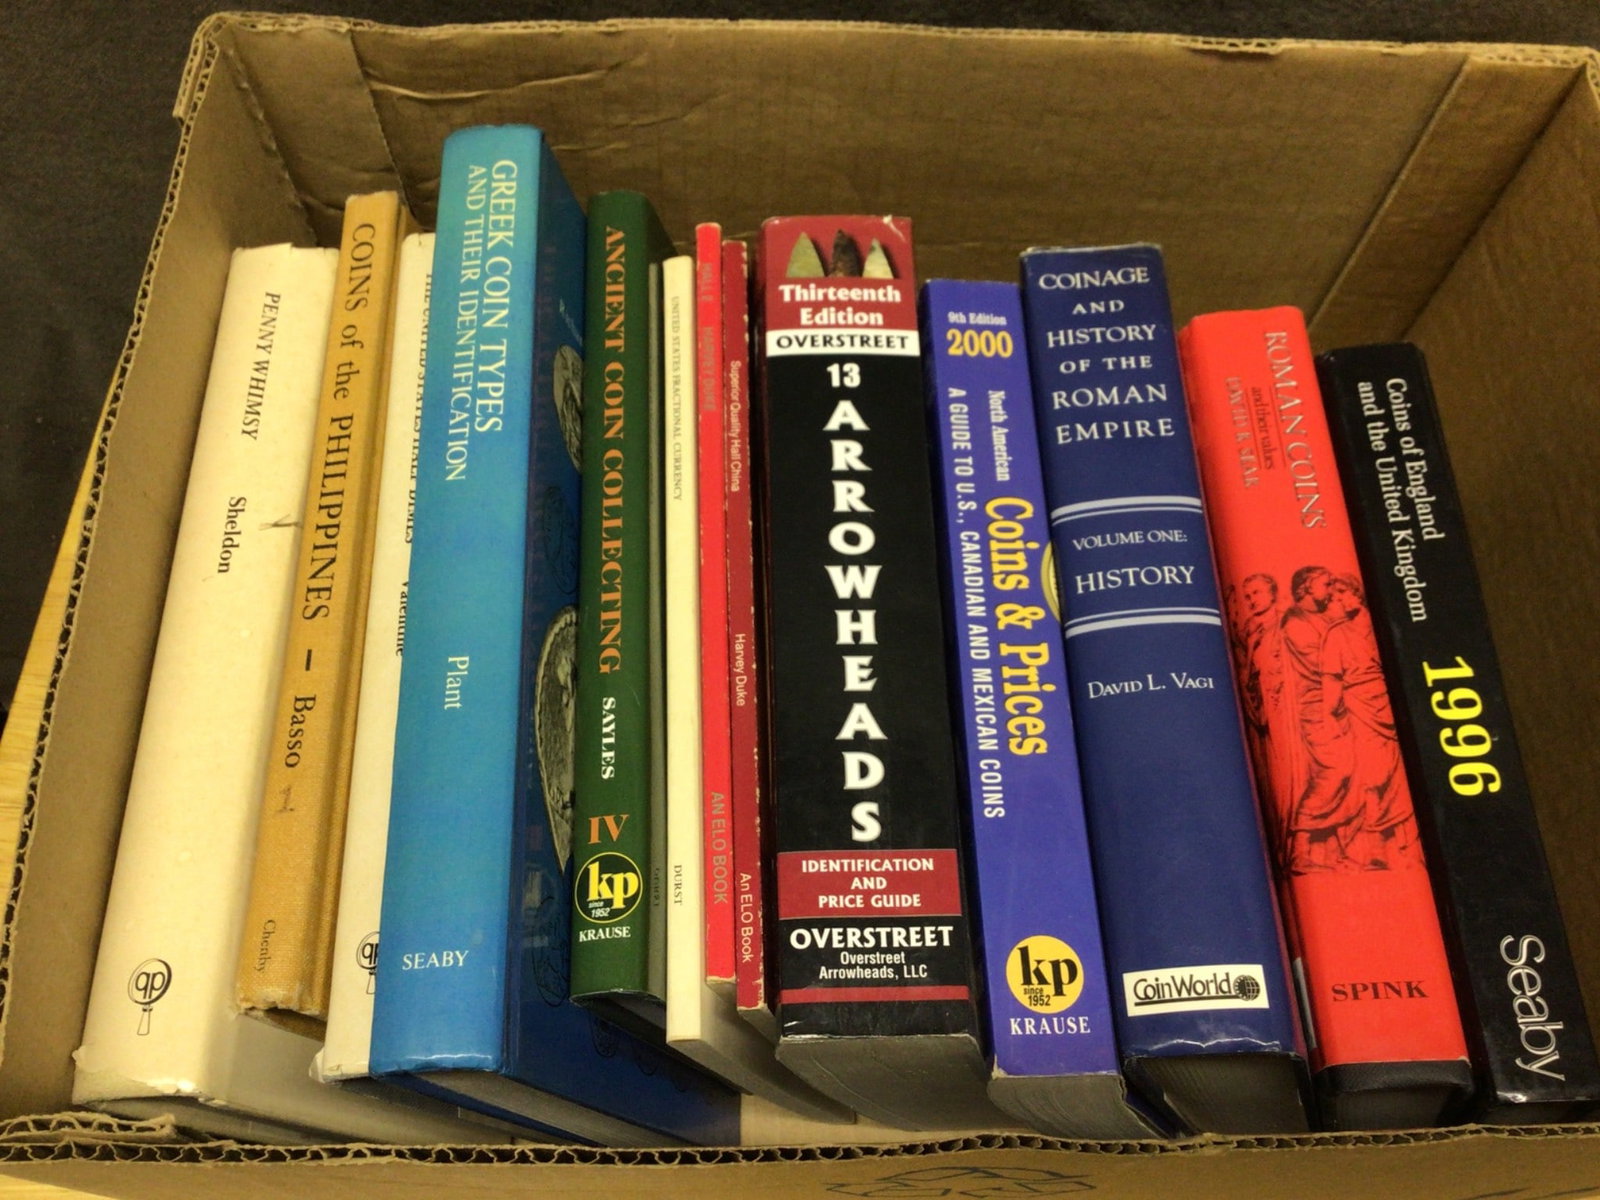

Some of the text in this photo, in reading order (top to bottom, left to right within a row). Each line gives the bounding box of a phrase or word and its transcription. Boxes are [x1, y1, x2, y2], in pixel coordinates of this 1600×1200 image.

[344, 223, 376, 313] COINS
[1038, 266, 1150, 290] COINAGE
[474, 159, 518, 433] GREEK COIN TYPES
[779, 284, 901, 302] Thirteenth
[1071, 300, 1125, 315] AND
[446, 164, 489, 482] AND THEIR IDENTIFICATION
[800, 308, 884, 326] Edition
[947, 311, 1007, 326] 9th Edition
[340, 324, 365, 349] of
[775, 333, 909, 349] OVERSTREET
[946, 328, 1013, 359] 2000
[1047, 324, 1157, 348] HISTORY
[241, 291, 281, 441] PENNY WHIMSY
[334, 361, 361, 401] the
[826, 362, 862, 388] 13
[1059, 355, 1153, 374] OF THE
[672, 296, 683, 501] UNITED STATES FRACTIONAL CURRENCY
[948, 387, 967, 397] A
[1052, 383, 1168, 410] ROMAN
[728, 360, 743, 492] Superior Quality Hall China
[949, 402, 972, 450] GUIDE
[988, 390, 1011, 482] North American
[1056, 418, 1176, 445] EMPIRE
[1225, 376, 1248, 428] DAVID
[1238, 447, 1260, 488] SEAR
[1252, 387, 1278, 470] and their values
[1264, 331, 1327, 529] ROMAN COINS
[598, 226, 626, 674] ANCIENT COIN COLLECTING
[954, 456, 974, 477] TO
[1386, 377, 1445, 541] Coins of England
[302, 414, 354, 621] PHILIPPINES
[1357, 381, 1428, 623] and the United Kingdom
[217, 496, 247, 574] Sheldon
[1072, 529, 1188, 551] VOLUME ONE:
[960, 531, 987, 617] CANADIAN
[1075, 565, 1196, 594] HISTORY
[968, 624, 991, 660] AND
[985, 497, 1056, 756] Coins & Prices
[444, 655, 470, 710] Plant
[733, 633, 746, 707] Harvey Duke
[1146, 673, 1166, 691] L.
[971, 668, 999, 751] MEXICAN
[1422, 655, 1502, 797] 1996
[283, 693, 317, 769] Basso
[601, 696, 616, 780] SAYLES
[979, 760, 1006, 818] COINS
[587, 813, 631, 846] IV
[711, 792, 728, 905] AN ELO BOOK
[802, 857, 935, 874] IDENTIFICATION
[586, 861, 640, 910] kp
[673, 864, 683, 905] DURST
[818, 893, 922, 909] PRICE GUIDE
[850, 876, 888, 890] AND
[591, 907, 611, 919] 1952
[738, 872, 754, 964] An ELO Book
[579, 926, 631, 943] KRAUSE
[789, 925, 954, 950] OVERSTREET
[401, 950, 470, 972] SEABY
[818, 964, 928, 982] Arrowheads, LLC
[839, 950, 906, 965] Overstreet
[1017, 945, 1078, 997] kp
[1023, 986, 1044, 995] since
[1028, 995, 1051, 1007] 1952
[1331, 980, 1430, 1003] SPINK
[1499, 934, 1566, 1082] Seaby
[1009, 1016, 1091, 1036] KRAUSE
